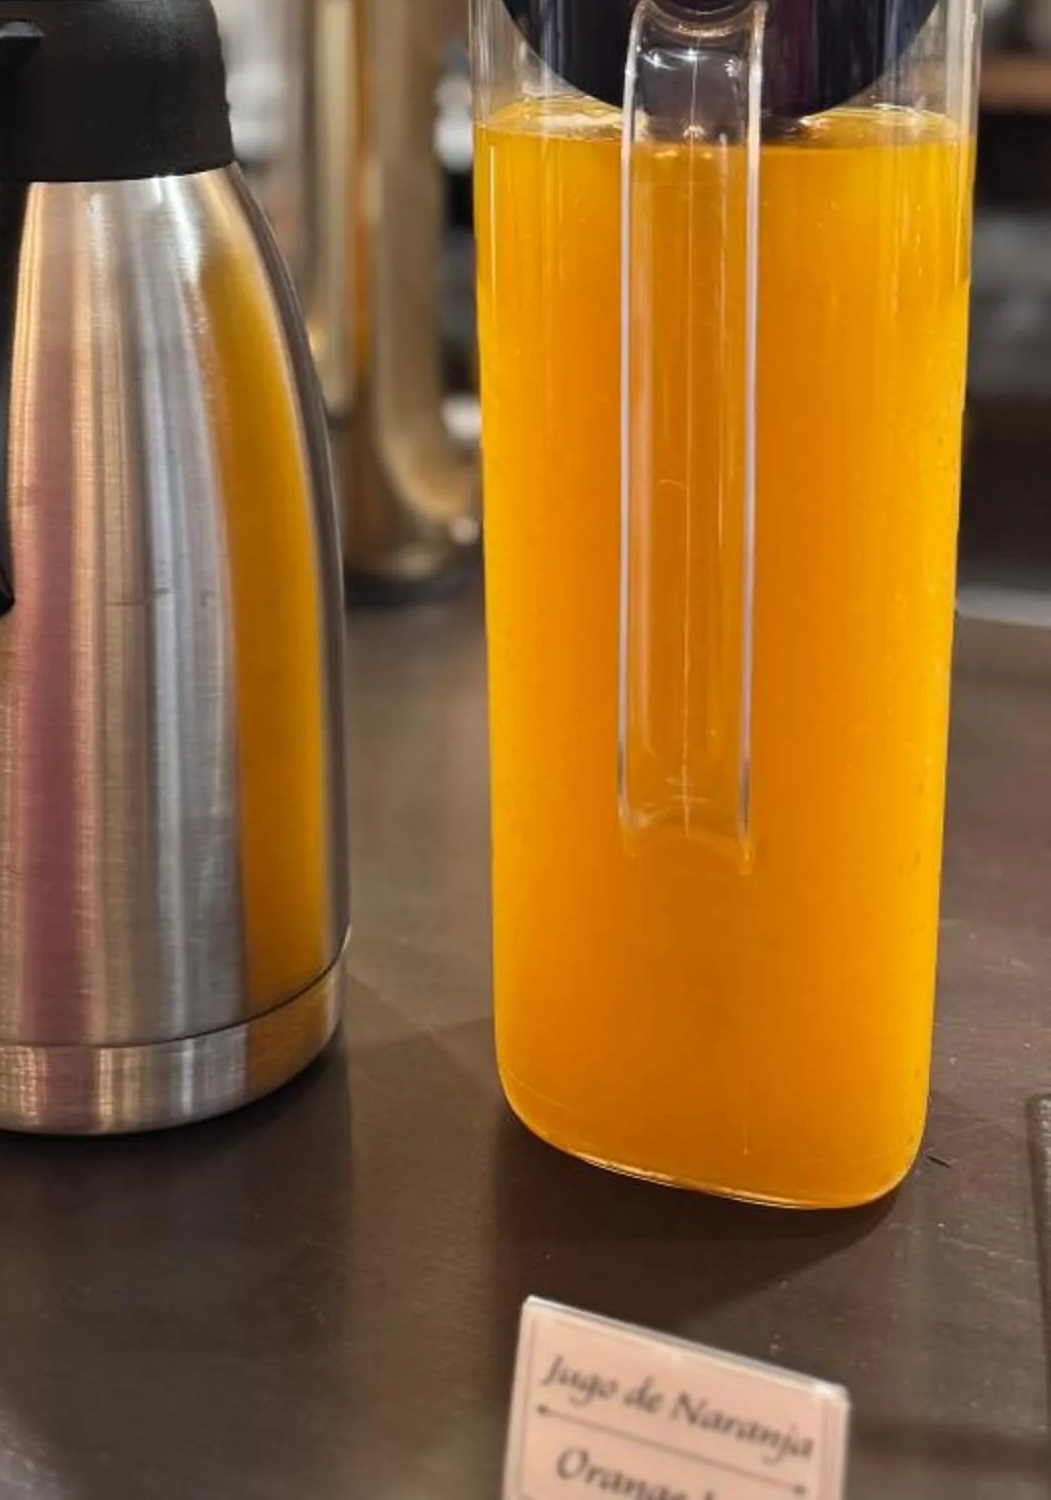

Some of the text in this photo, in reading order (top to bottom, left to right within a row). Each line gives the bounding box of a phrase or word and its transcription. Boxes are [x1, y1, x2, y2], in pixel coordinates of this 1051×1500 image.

[540, 1354, 815, 1464] Jugo de Naranja
[555, 1447, 689, 1500] Oran
